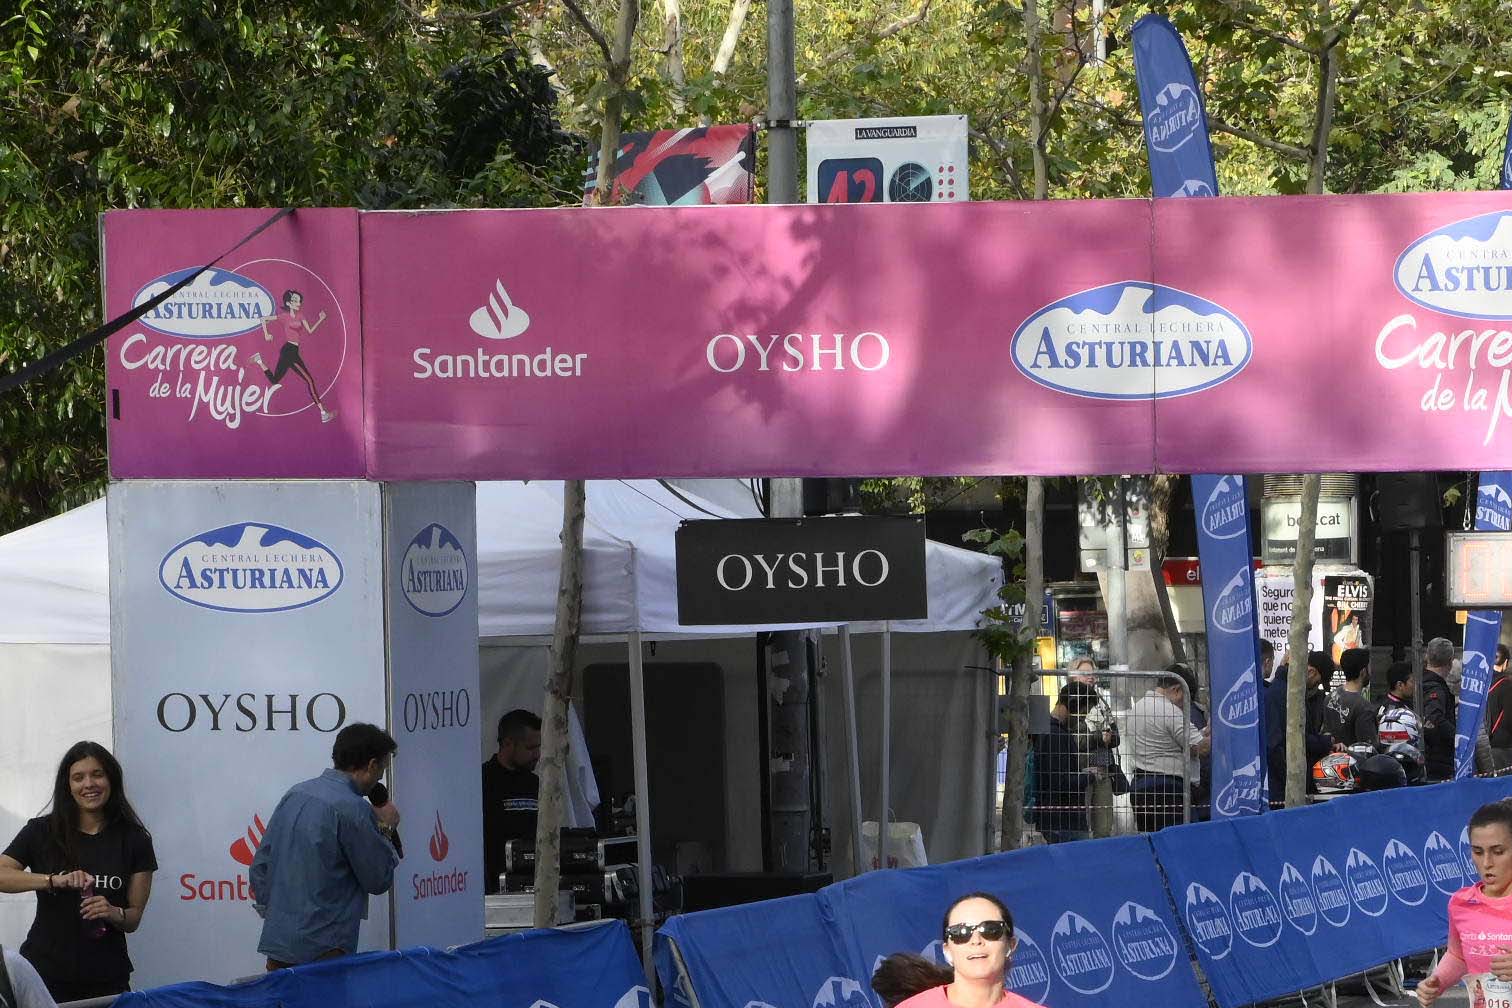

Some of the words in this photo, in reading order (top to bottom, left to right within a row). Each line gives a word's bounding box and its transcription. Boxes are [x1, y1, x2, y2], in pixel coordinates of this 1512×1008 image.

[172, 290, 208, 299] ENTRAL
[214, 291, 260, 299] LECHERA
[1066, 322, 1140, 334] CENTRAL
[1151, 321, 1225, 334] LECHERA
[120, 333, 237, 371] Carrera
[413, 346, 588, 378] Santander
[706, 332, 889, 373] OYSHO
[1030, 325, 1233, 370] ASTURIANA
[149, 371, 171, 398] de
[175, 370, 192, 398] la
[188, 368, 283, 429] Mujer
[1421, 371, 1455, 412] de
[1463, 370, 1487, 412] la
[1287, 512, 1341, 527] b.cat
[175, 555, 330, 591] ASTURIANA
[201, 553, 260, 563] CENTRAL
[265, 552, 324, 563] LECHERA
[716, 548, 889, 591] OYSHO
[407, 559, 465, 593] ASTURIANA
[1338, 585, 1368, 597] ELVIS
[1263, 602, 1279, 614] que
[1263, 613, 1295, 626] quiere
[157, 692, 347, 734] OYSHO
[404, 688, 471, 734] OYSHO
[412, 867, 469, 902] Santander
[1005, 961, 1047, 989] STURIANA
[1056, 945, 1112, 977] ASTURIANA
[1488, 999, 1510, 1008] 016
